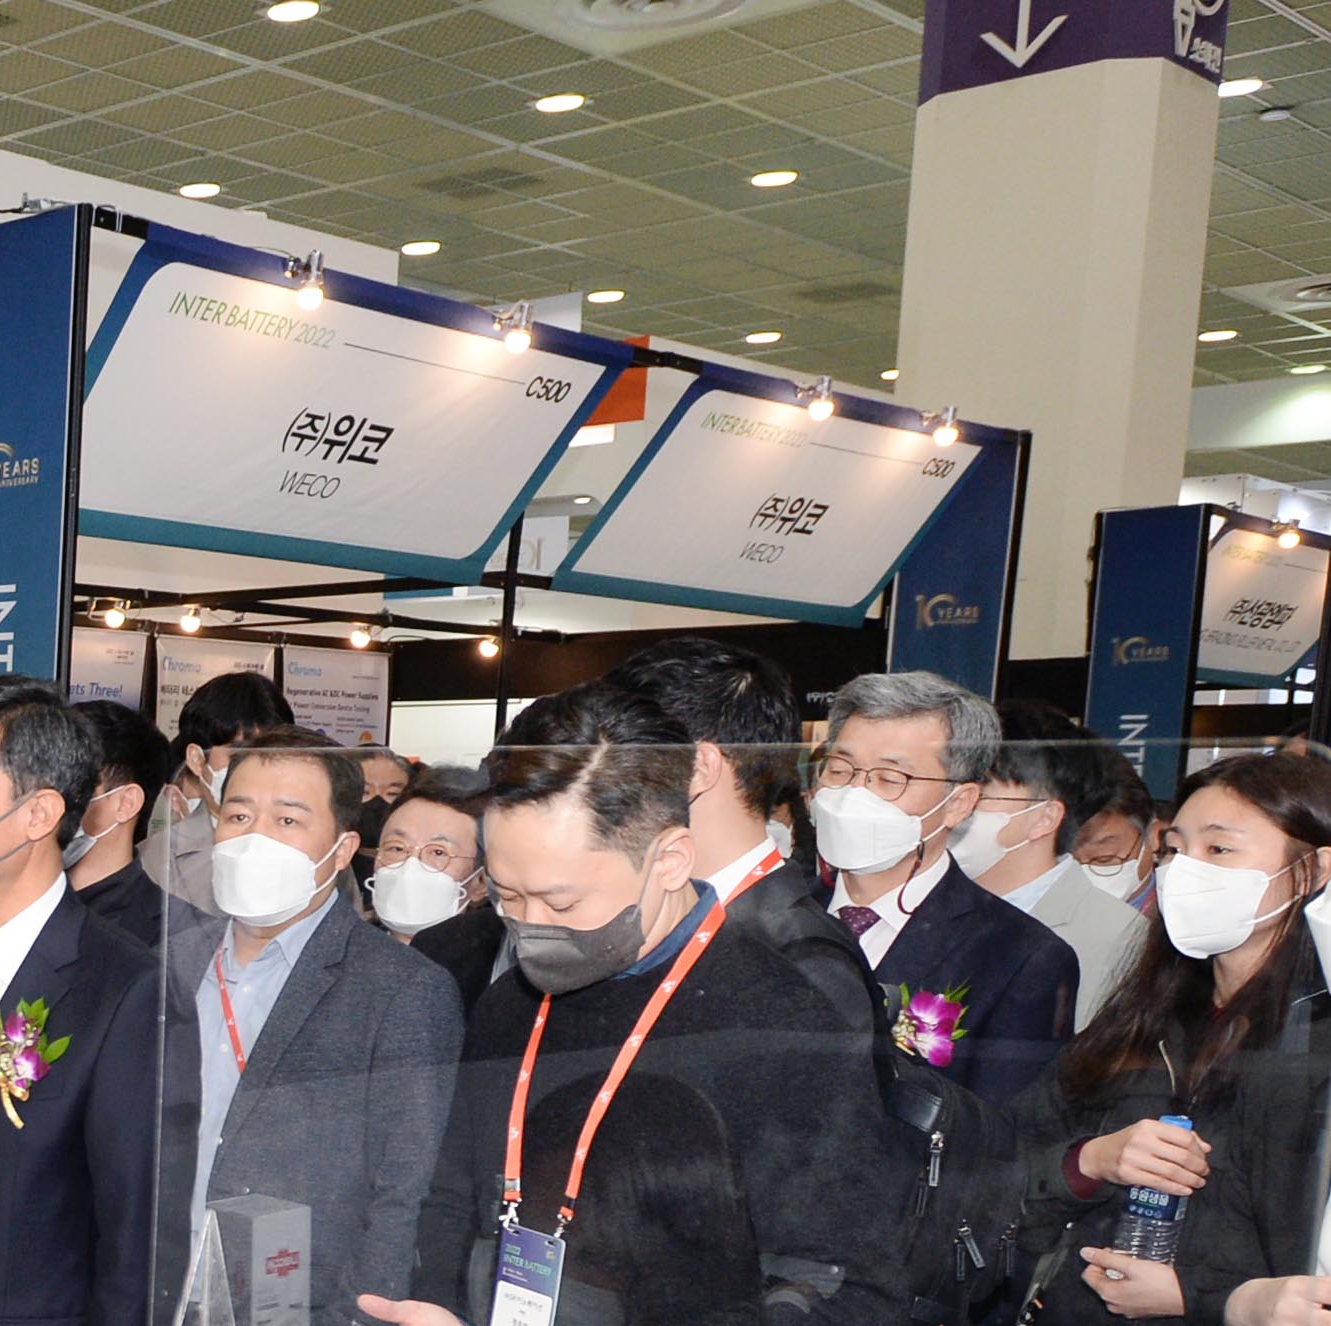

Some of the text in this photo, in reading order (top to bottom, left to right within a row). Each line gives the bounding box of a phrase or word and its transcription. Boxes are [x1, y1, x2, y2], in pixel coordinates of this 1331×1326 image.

[525, 374, 573, 405] C500
[281, 407, 394, 465] (주)위코
[922, 458, 955, 478] C500
[279, 470, 341, 498] WECO
[749, 493, 829, 535] (주)위코
[739, 541, 784, 564] WECO
[163, 656, 201, 672] Chroma
[90, 683, 123, 698] Three!
[1117, 714, 1150, 778] INT
